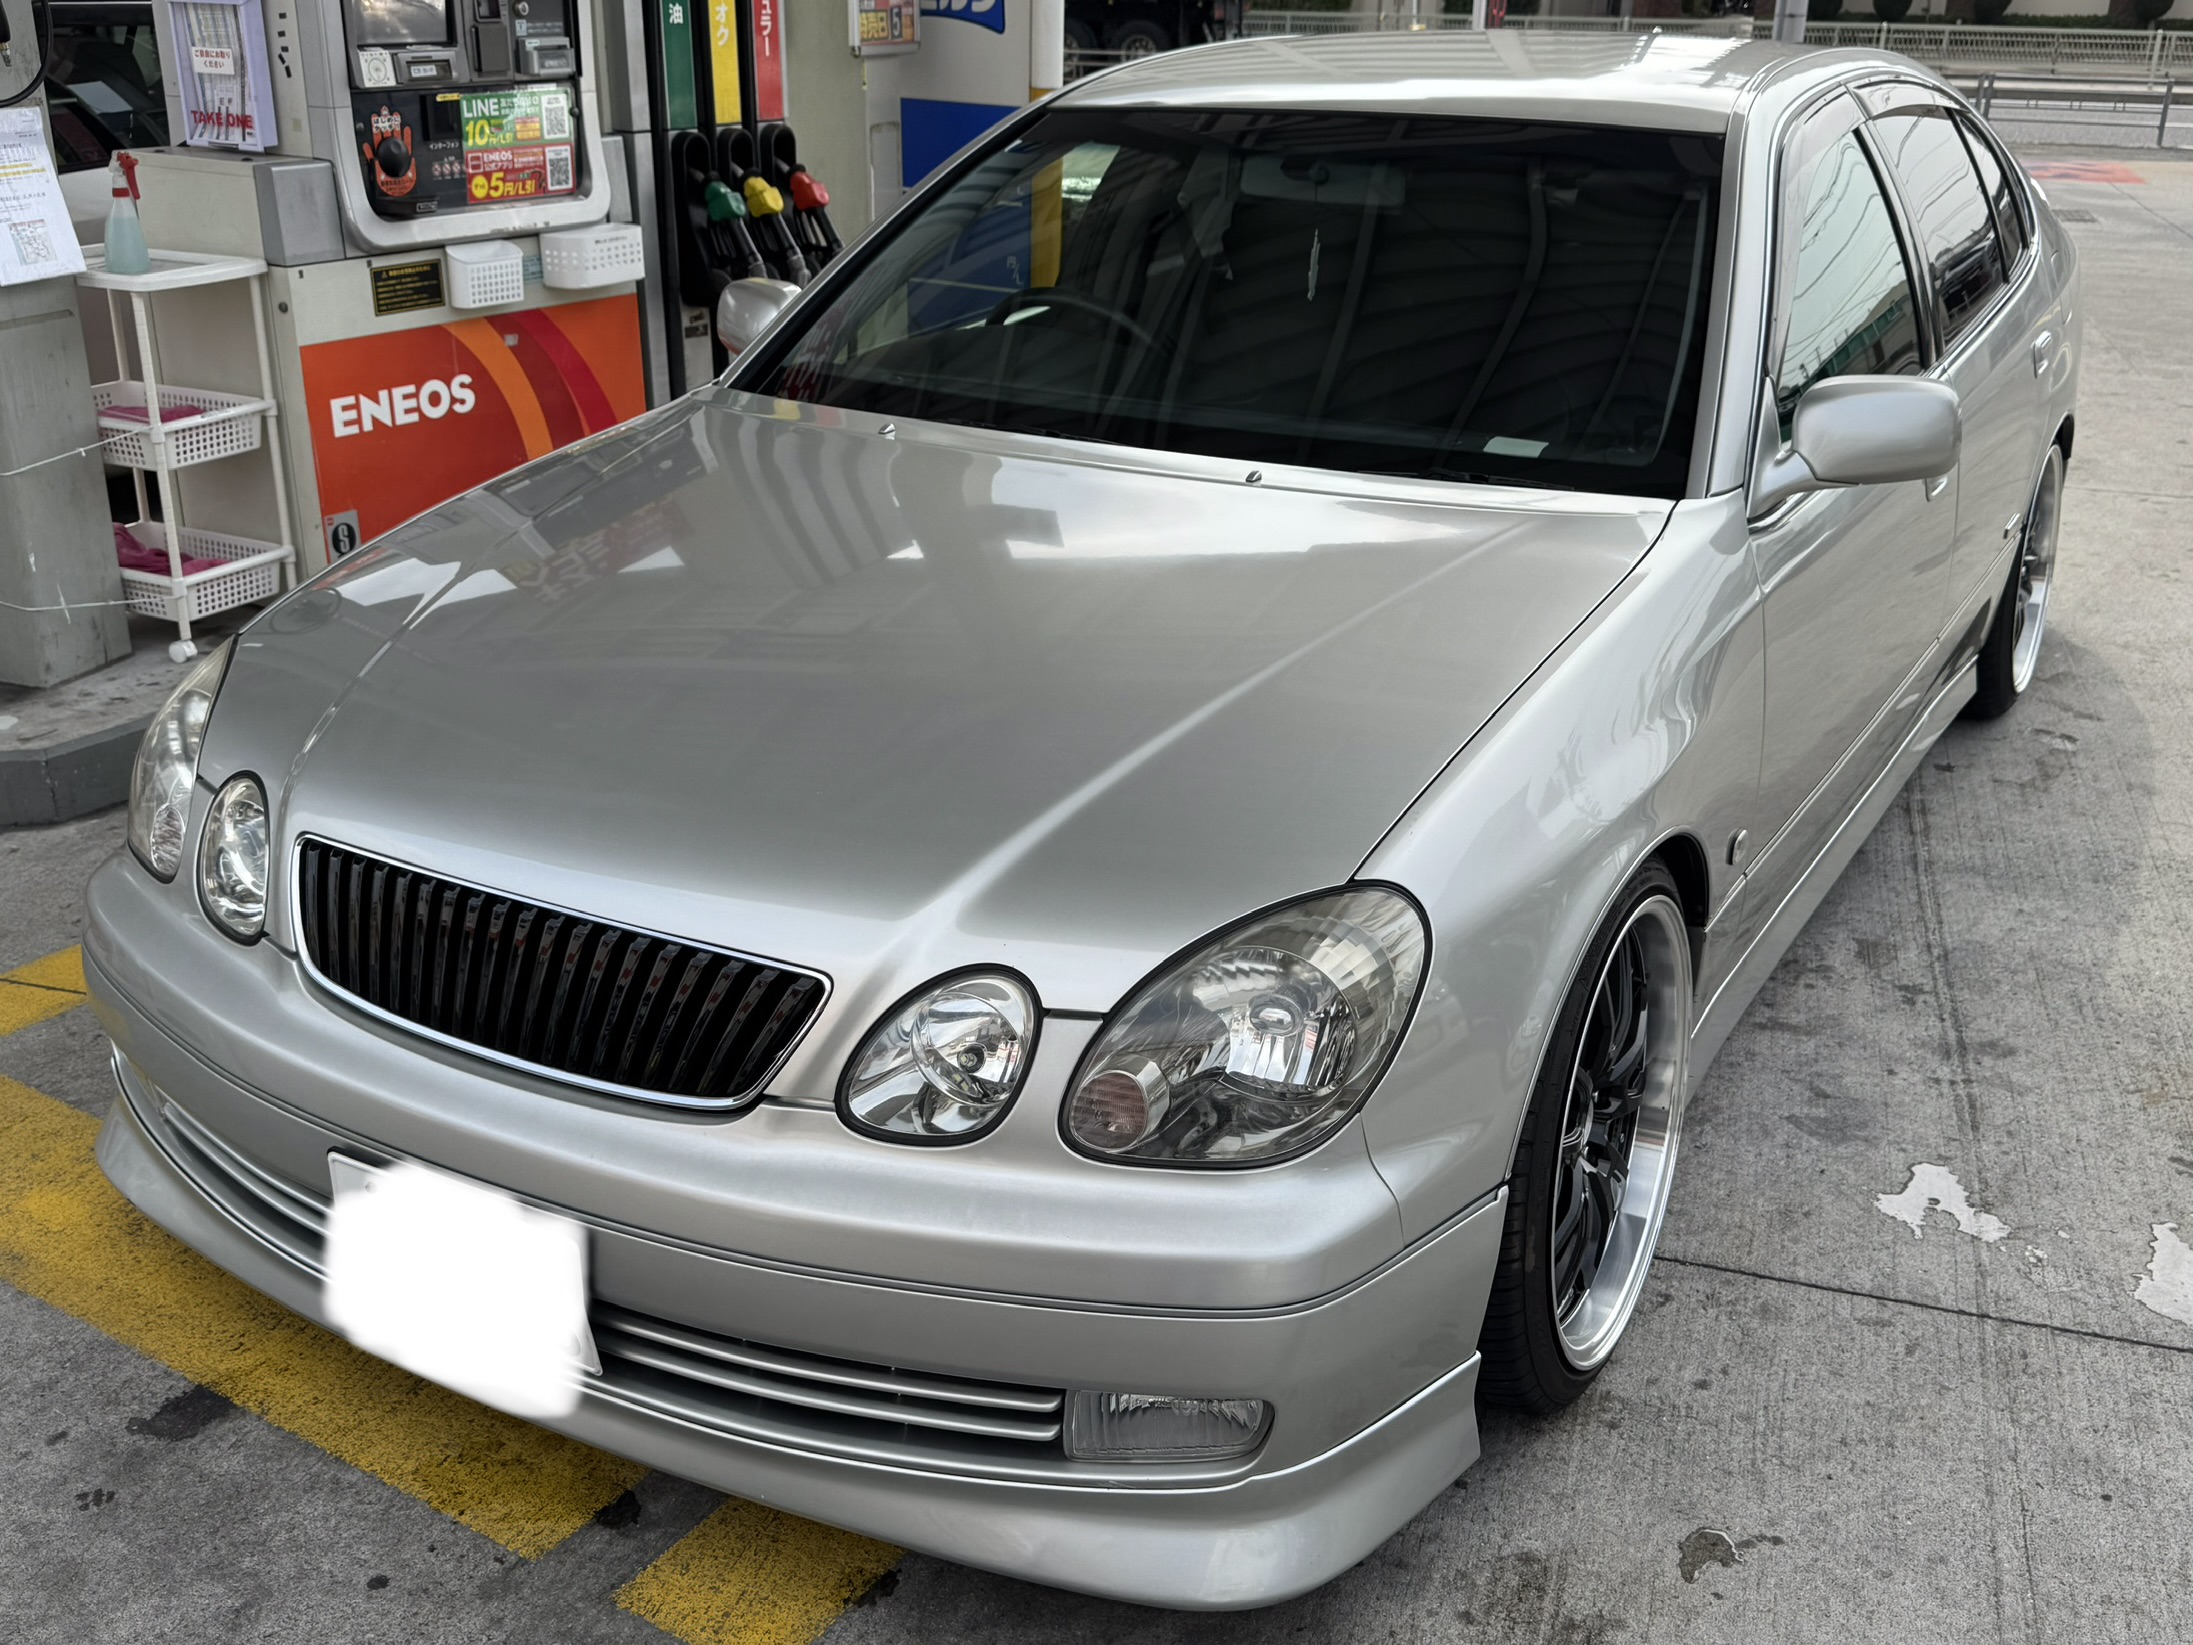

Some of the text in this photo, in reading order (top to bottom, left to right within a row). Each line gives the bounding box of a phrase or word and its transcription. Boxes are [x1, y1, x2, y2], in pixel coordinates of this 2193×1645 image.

[668, 2, 684, 24] 油
[715, 2, 730, 47] オク
[203, 60, 225, 69] ください
[462, 98, 500, 118] LINE
[191, 111, 254, 129] TAKE ONE
[483, 150, 513, 161] ENEOS
[330, 373, 476, 438] ENEOS
